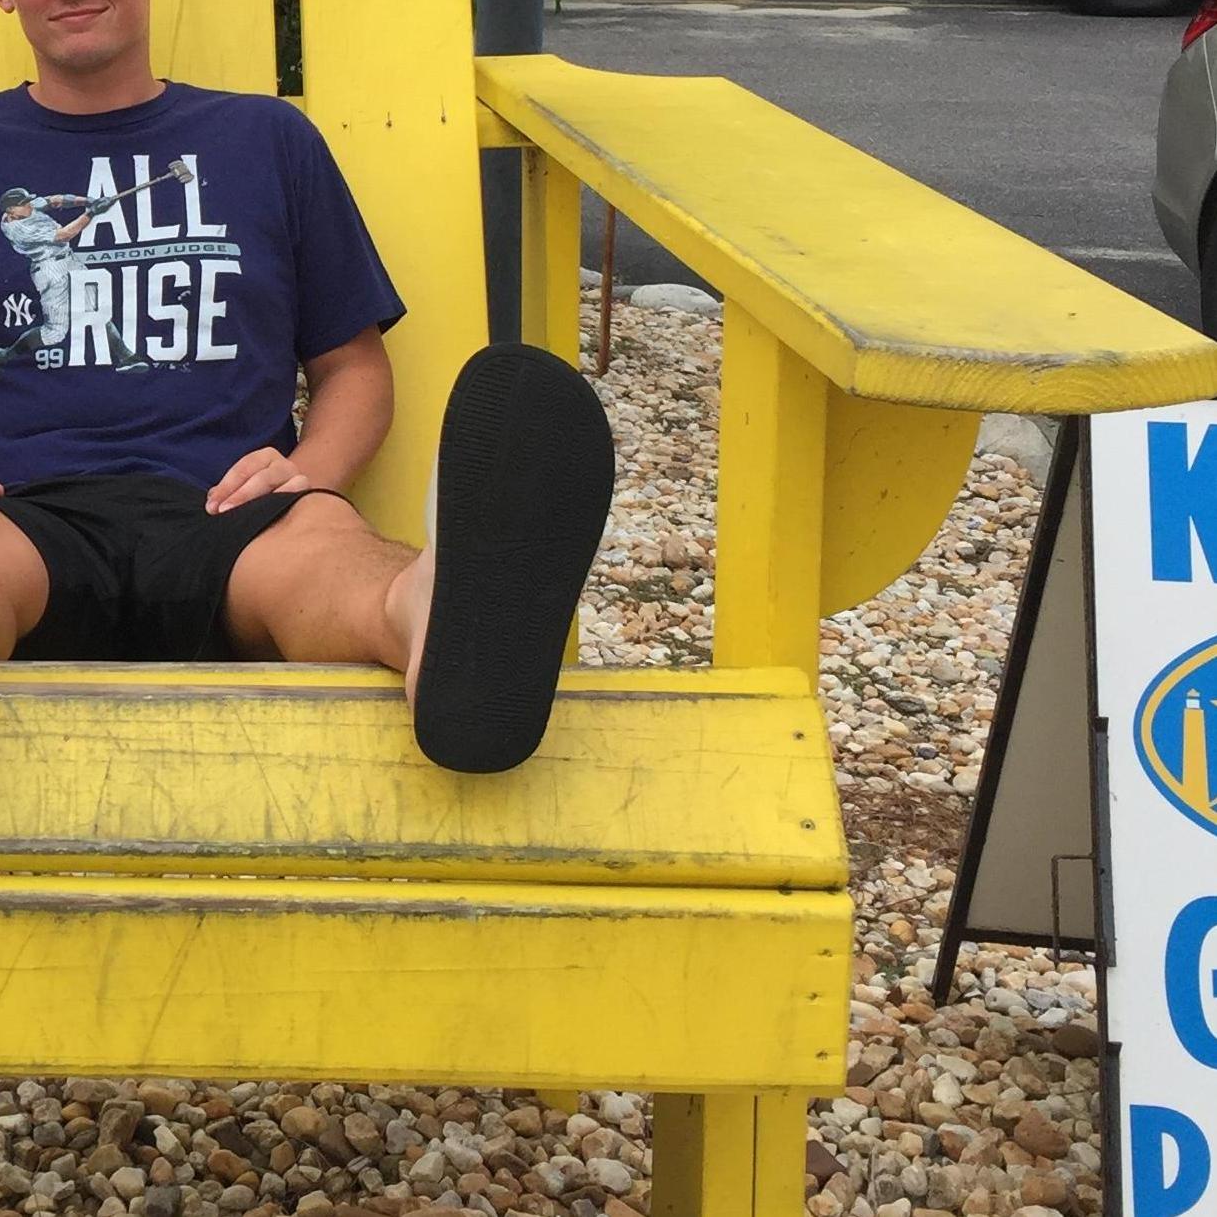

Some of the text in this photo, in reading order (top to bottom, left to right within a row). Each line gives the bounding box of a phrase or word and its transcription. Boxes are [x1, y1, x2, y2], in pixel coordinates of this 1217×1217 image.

[77, 154, 228, 248] ALL
[85, 243, 228, 262] AARON JUDGE
[2, 293, 34, 328] NY
[68, 258, 242, 366] RISE
[35, 348, 64, 370] 99
